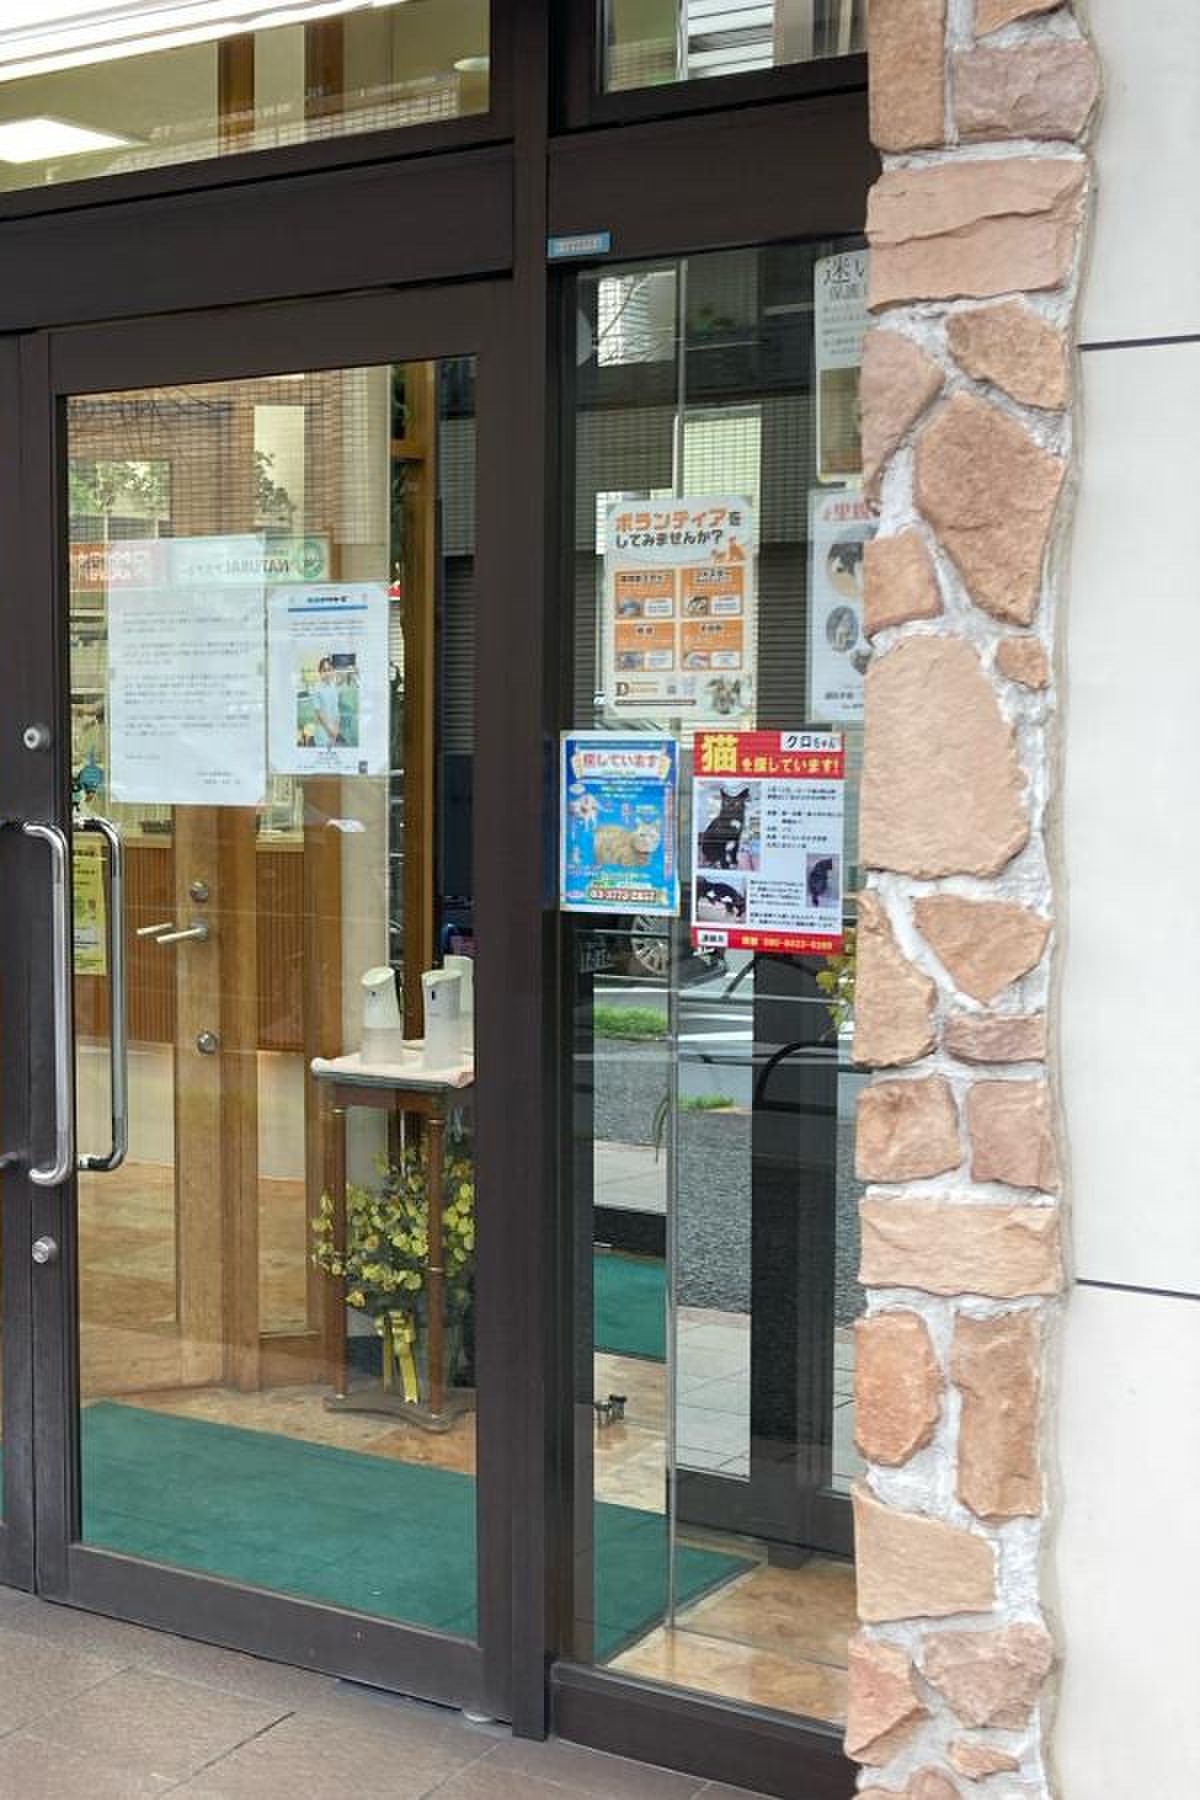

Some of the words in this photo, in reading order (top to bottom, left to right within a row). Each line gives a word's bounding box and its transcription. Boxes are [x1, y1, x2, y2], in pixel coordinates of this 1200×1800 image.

[786, 735, 836, 749] クロちゃん
